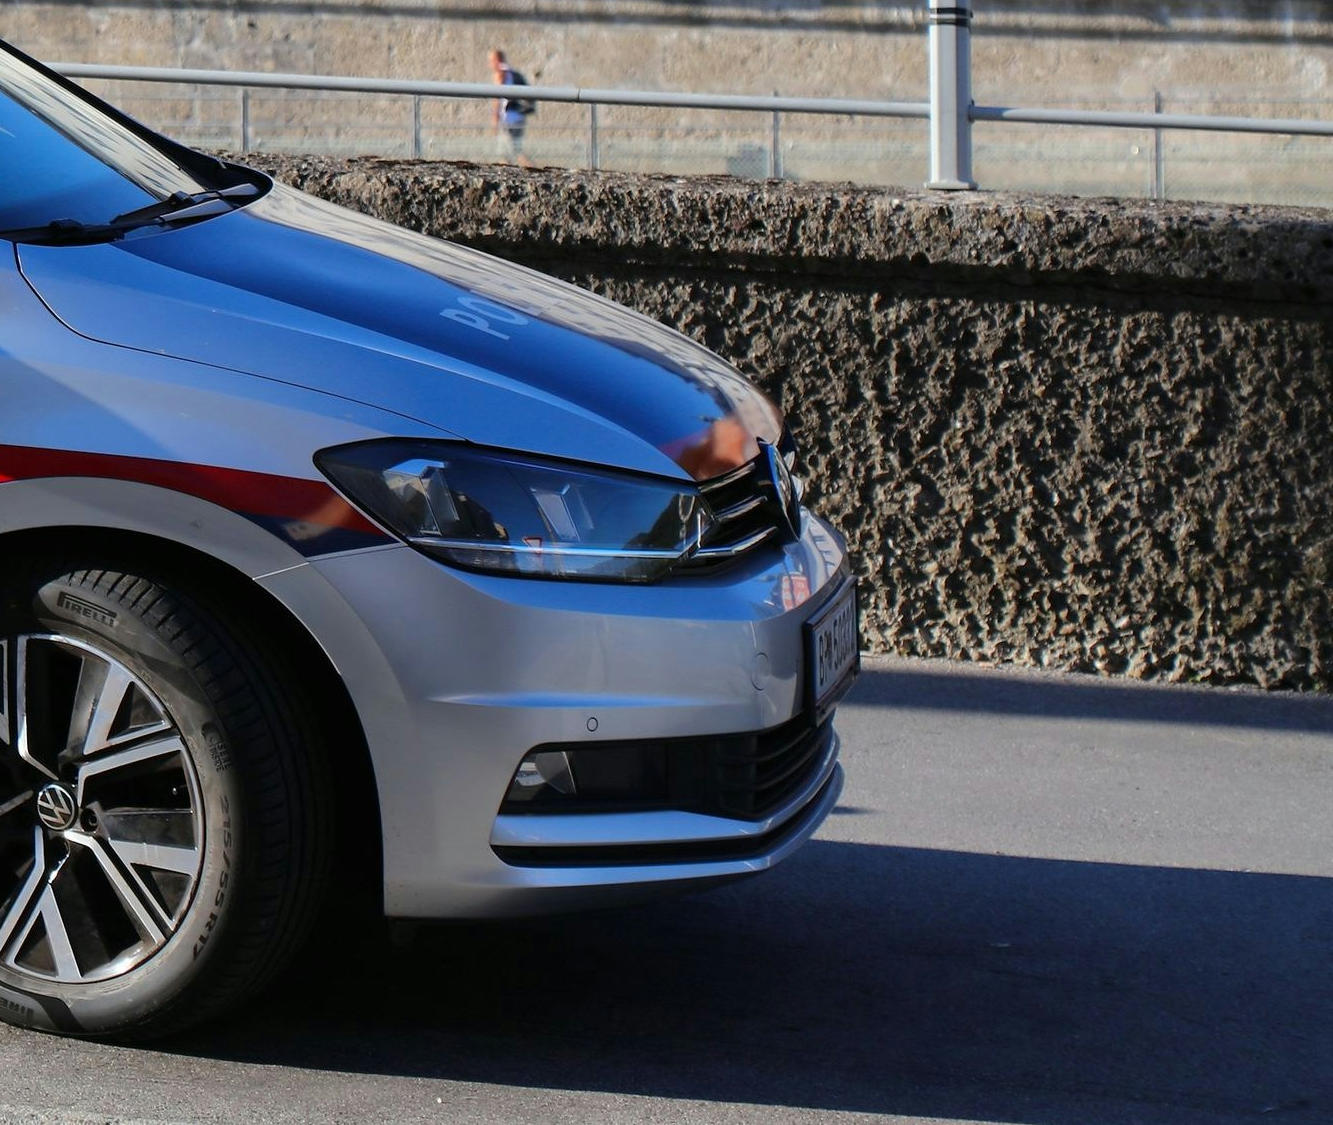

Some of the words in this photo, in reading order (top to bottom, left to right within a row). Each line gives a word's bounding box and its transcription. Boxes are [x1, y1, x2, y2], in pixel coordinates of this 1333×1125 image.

[56, 591, 118, 628] PIRELLI
[214, 795, 232, 908] 215/55
[192, 912, 218, 962] R17
